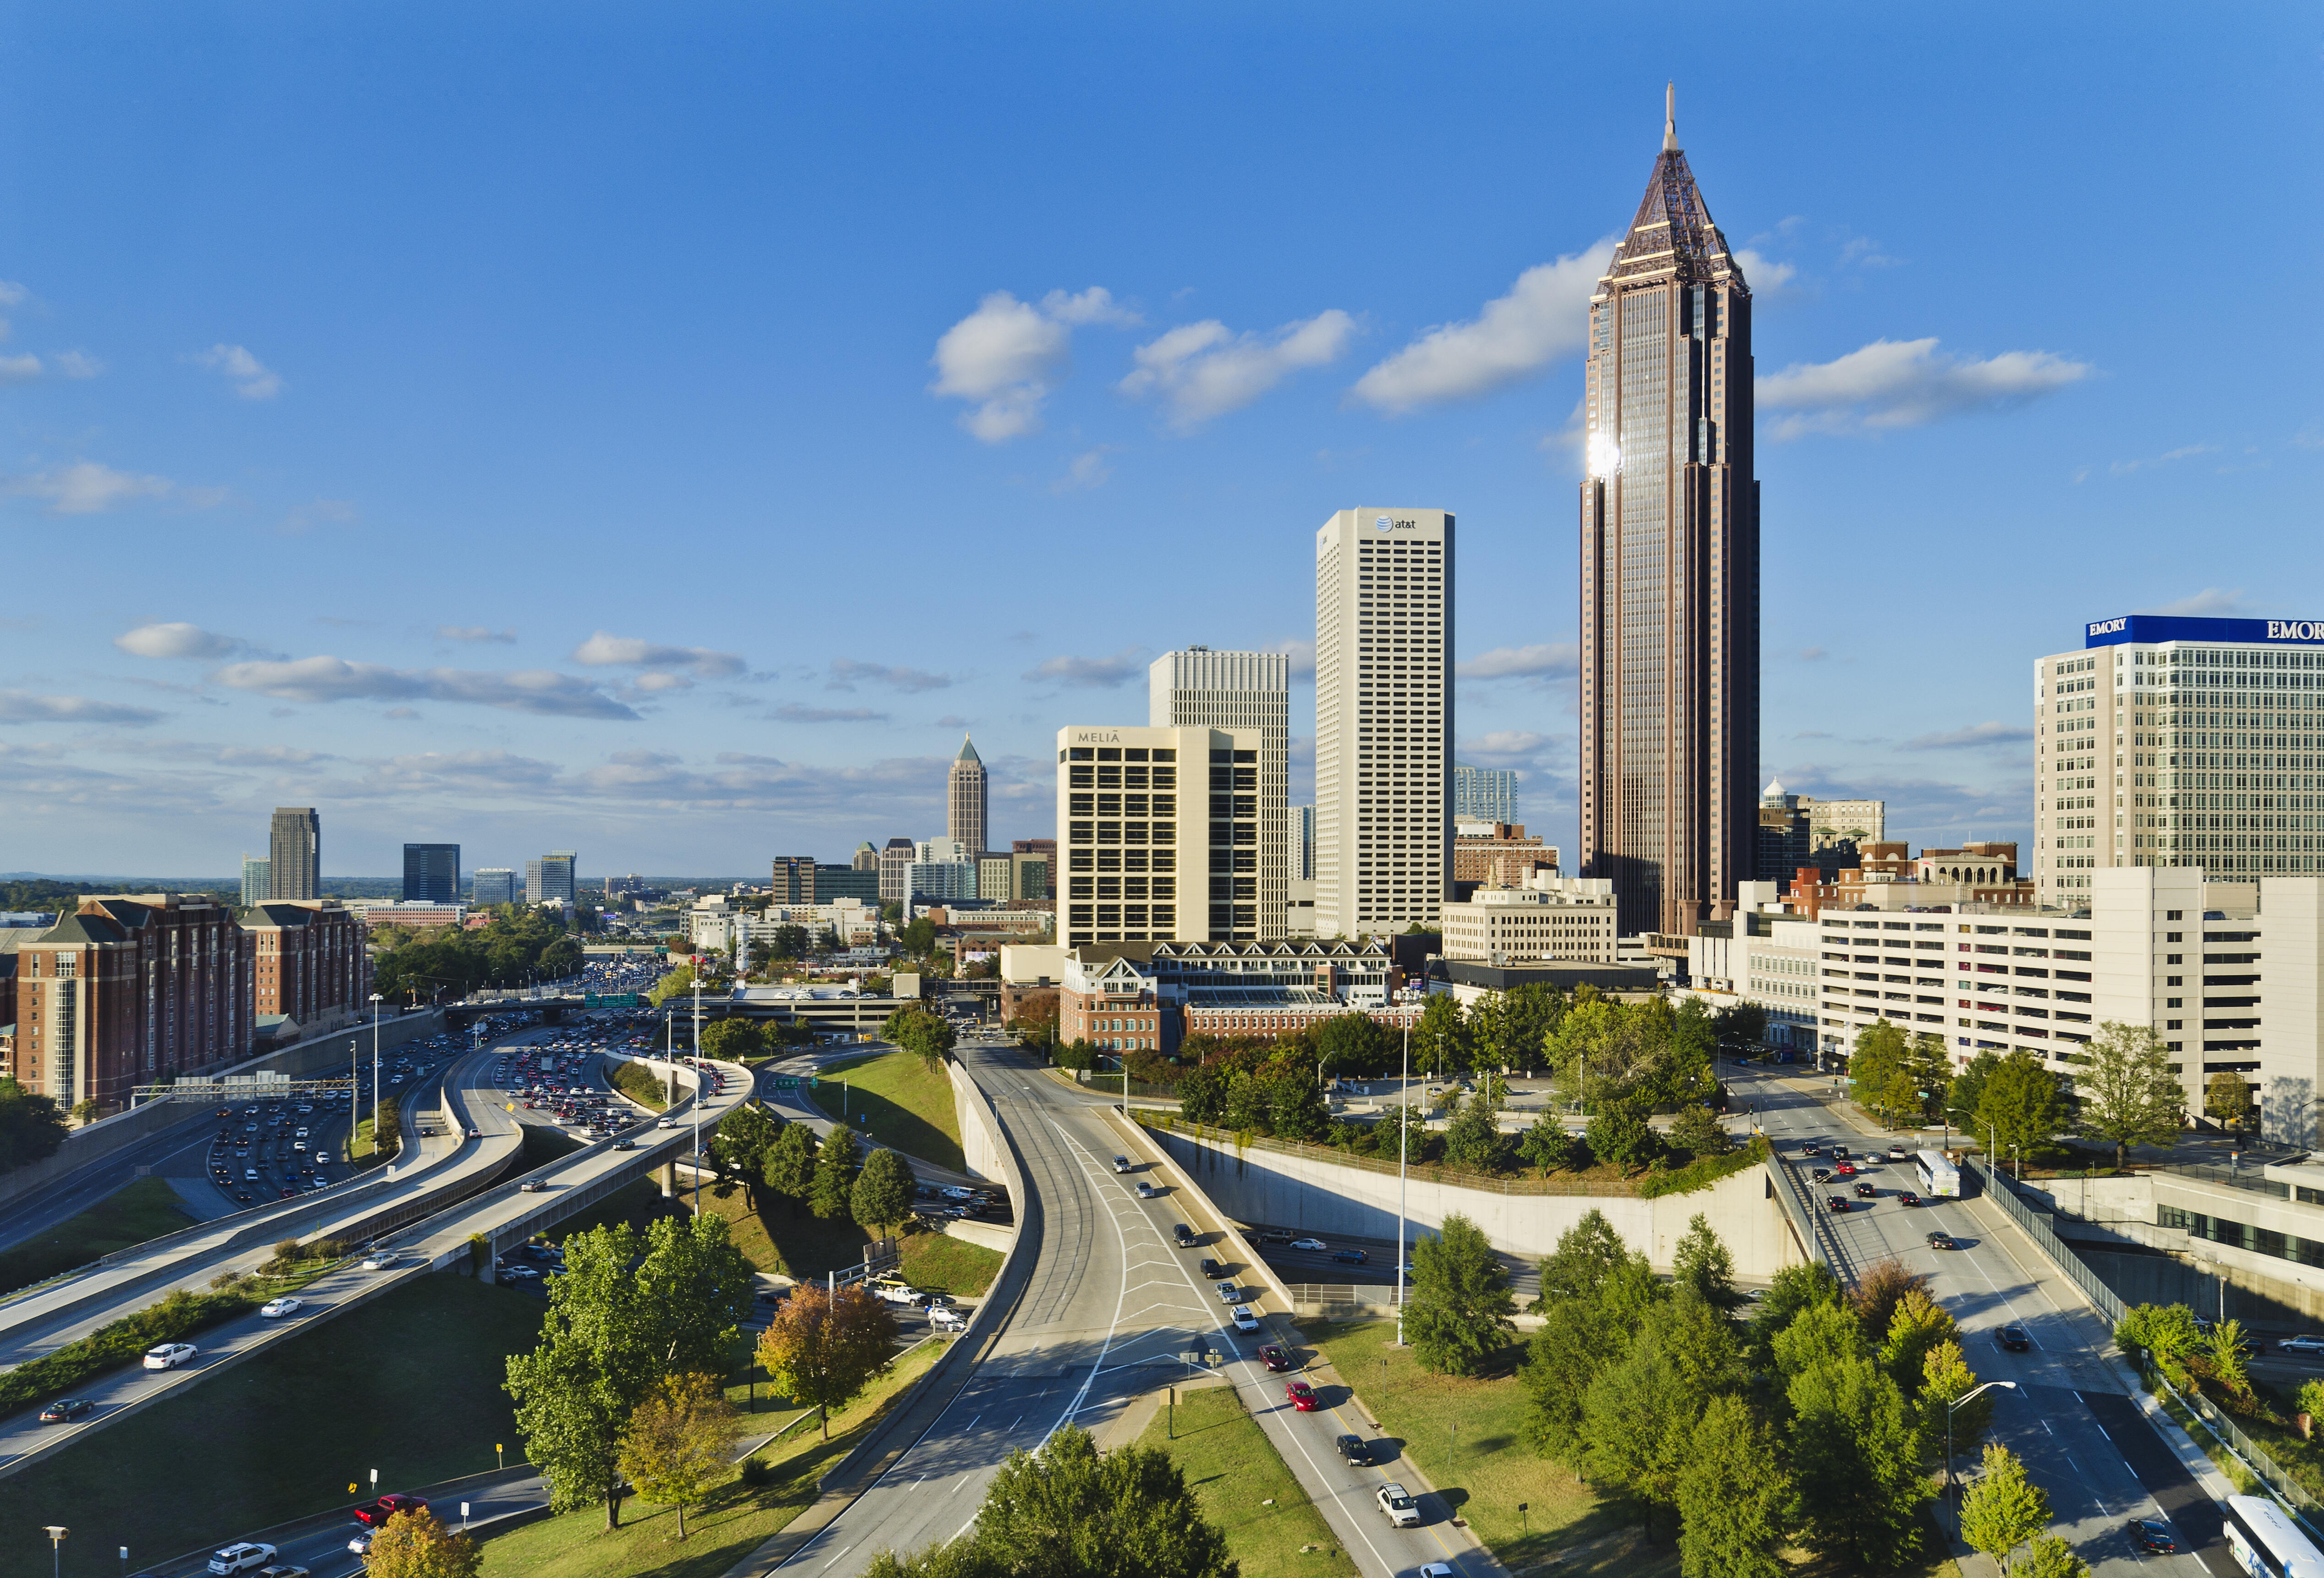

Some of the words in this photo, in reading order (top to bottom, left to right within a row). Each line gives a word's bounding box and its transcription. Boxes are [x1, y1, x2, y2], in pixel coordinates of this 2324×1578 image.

[1395, 520, 1416, 529] at&t
[2089, 617, 2127, 636] EMORY
[2267, 621, 2324, 640] EMOR
